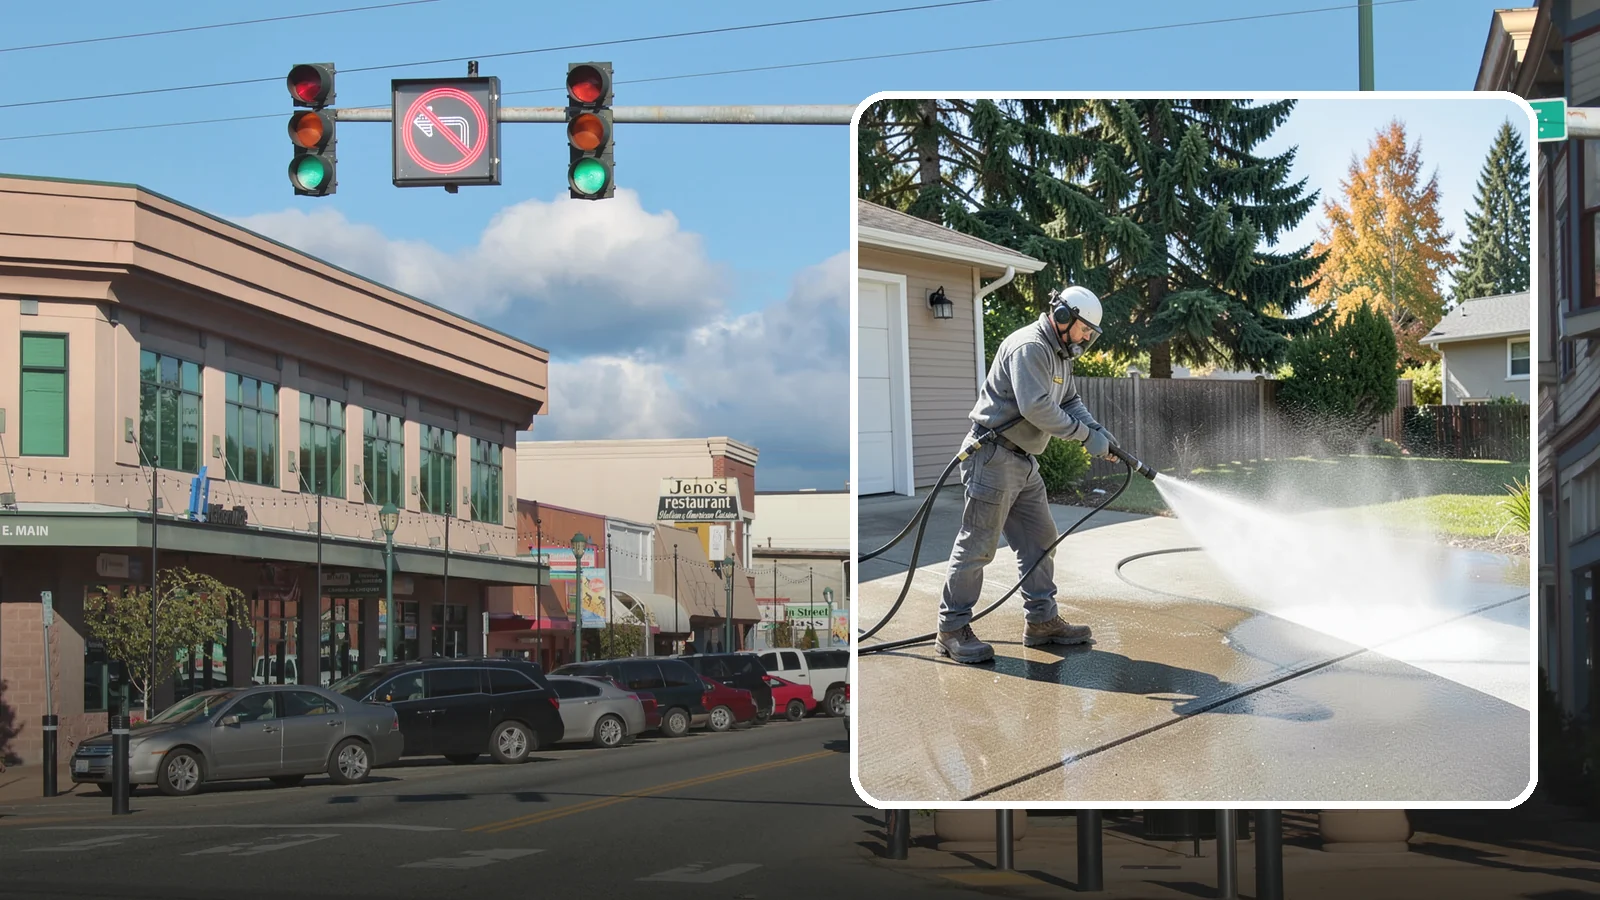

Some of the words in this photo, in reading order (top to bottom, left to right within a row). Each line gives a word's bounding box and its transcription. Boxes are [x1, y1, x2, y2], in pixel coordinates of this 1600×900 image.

[669, 480, 728, 495] Jeno's
[665, 496, 731, 509] restaurant
[659, 510, 681, 520] Italian
[686, 510, 715, 519] American
[715, 509, 738, 520] Cuisine
[2, 525, 13, 536] E.
[15, 525, 49, 536] MAIN
[797, 606, 829, 617] Street
[791, 619, 824, 628] lass
